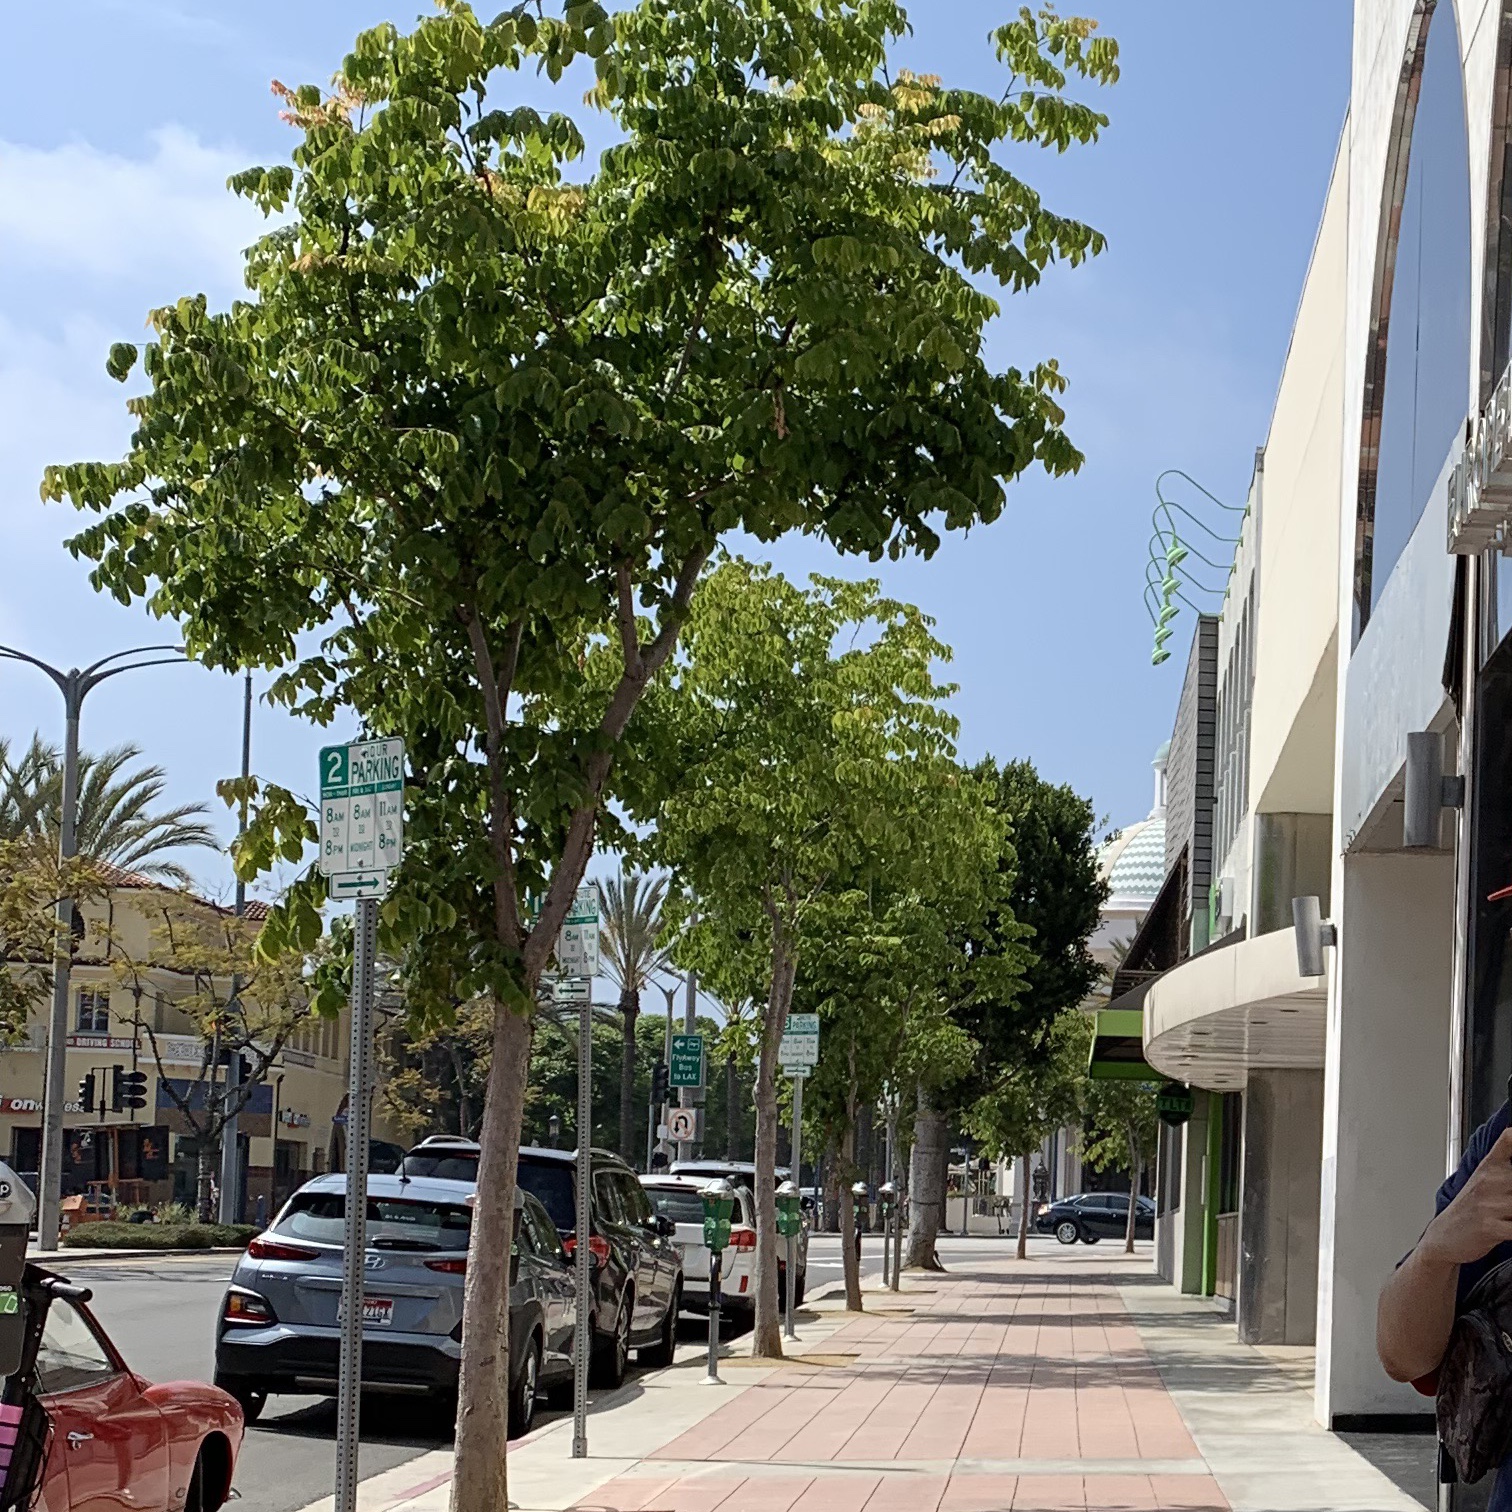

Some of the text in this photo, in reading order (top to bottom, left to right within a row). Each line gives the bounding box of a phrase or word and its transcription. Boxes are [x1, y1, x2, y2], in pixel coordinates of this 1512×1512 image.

[327, 751, 342, 783] 2
[351, 755, 399, 784] PARKING
[76, 1037, 107, 1047] DRIVING
